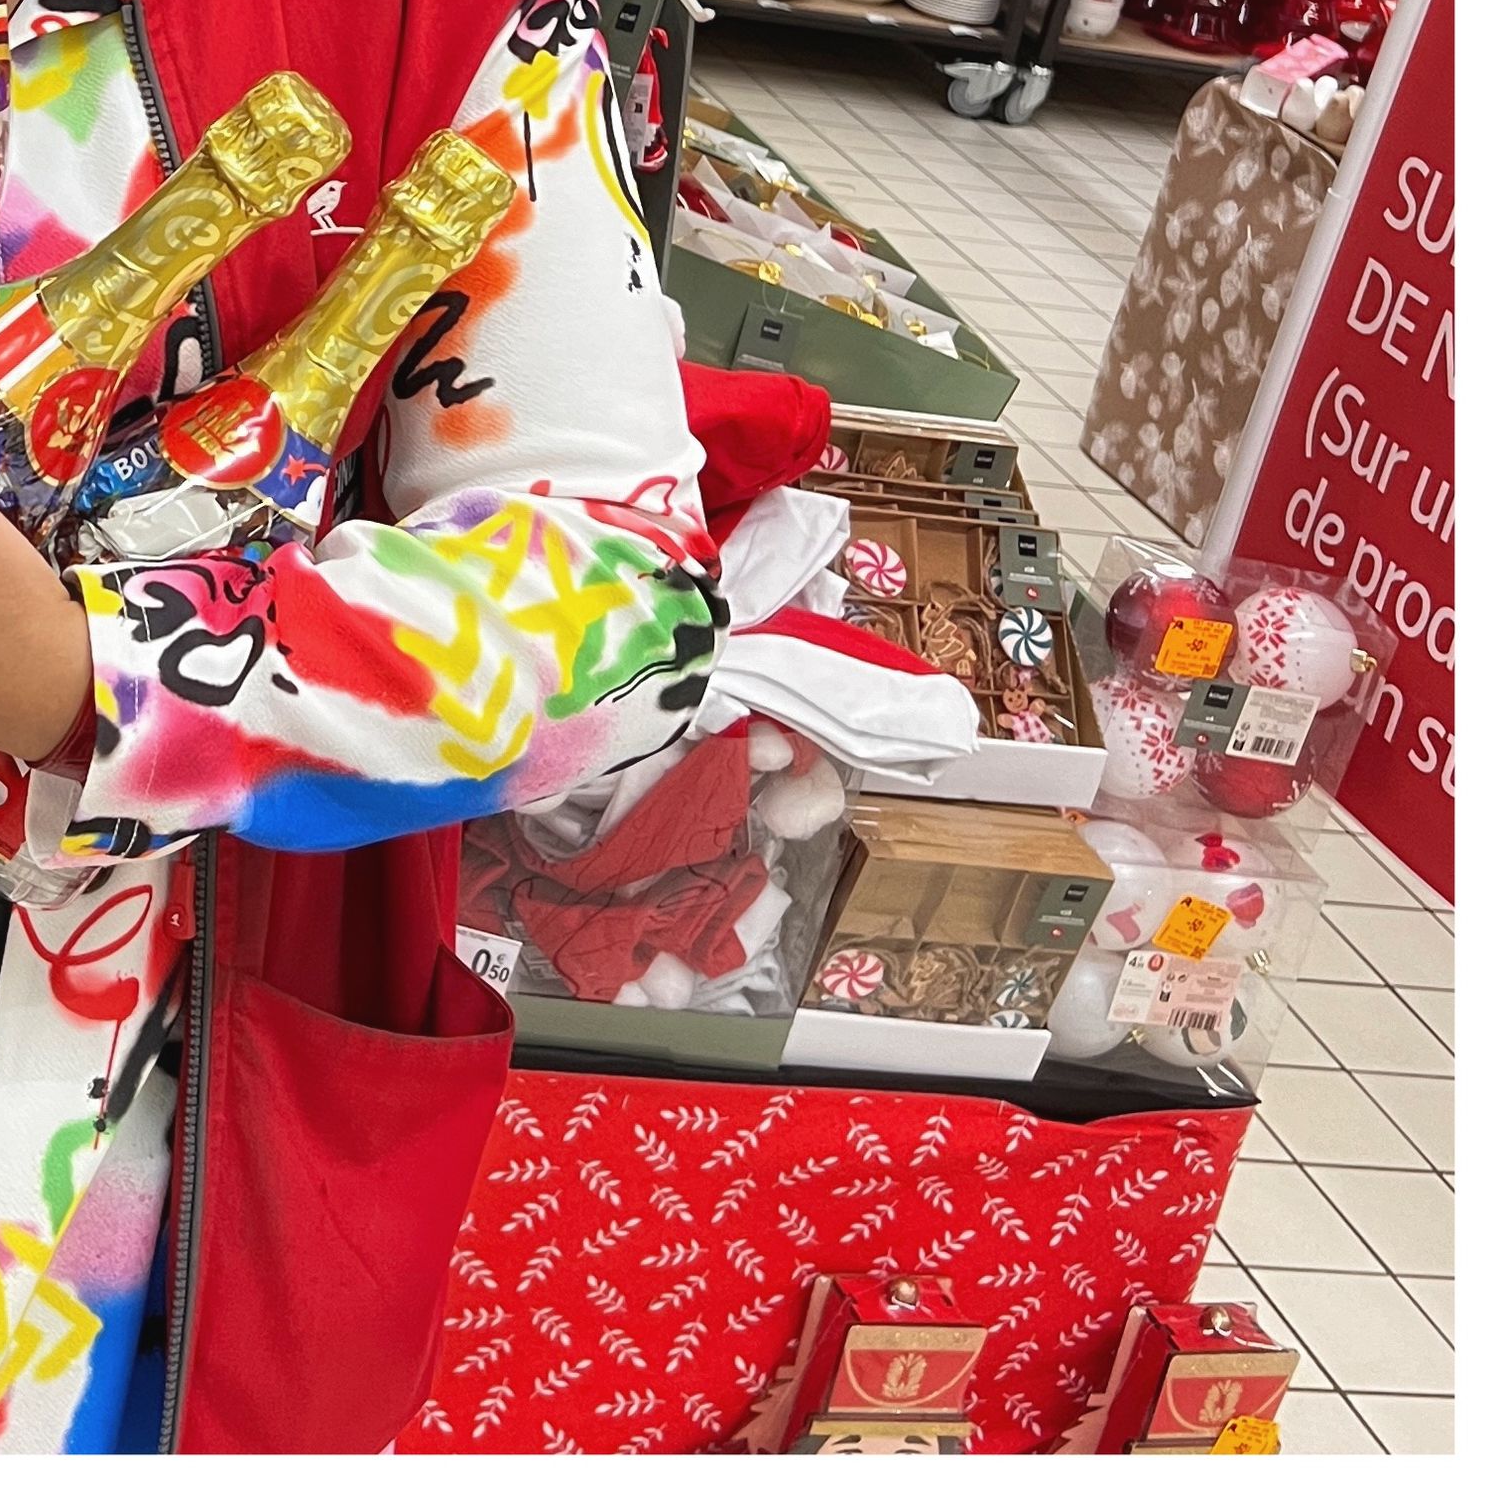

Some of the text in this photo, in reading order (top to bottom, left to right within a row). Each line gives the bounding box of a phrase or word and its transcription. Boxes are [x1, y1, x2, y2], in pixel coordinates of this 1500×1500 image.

[1383, 156, 1455, 255] SU
[1347, 257, 1430, 366] DE
[112, 434, 162, 481] BOU
[1305, 367, 1409, 494] (Sur
[1285, 477, 1345, 567] de
